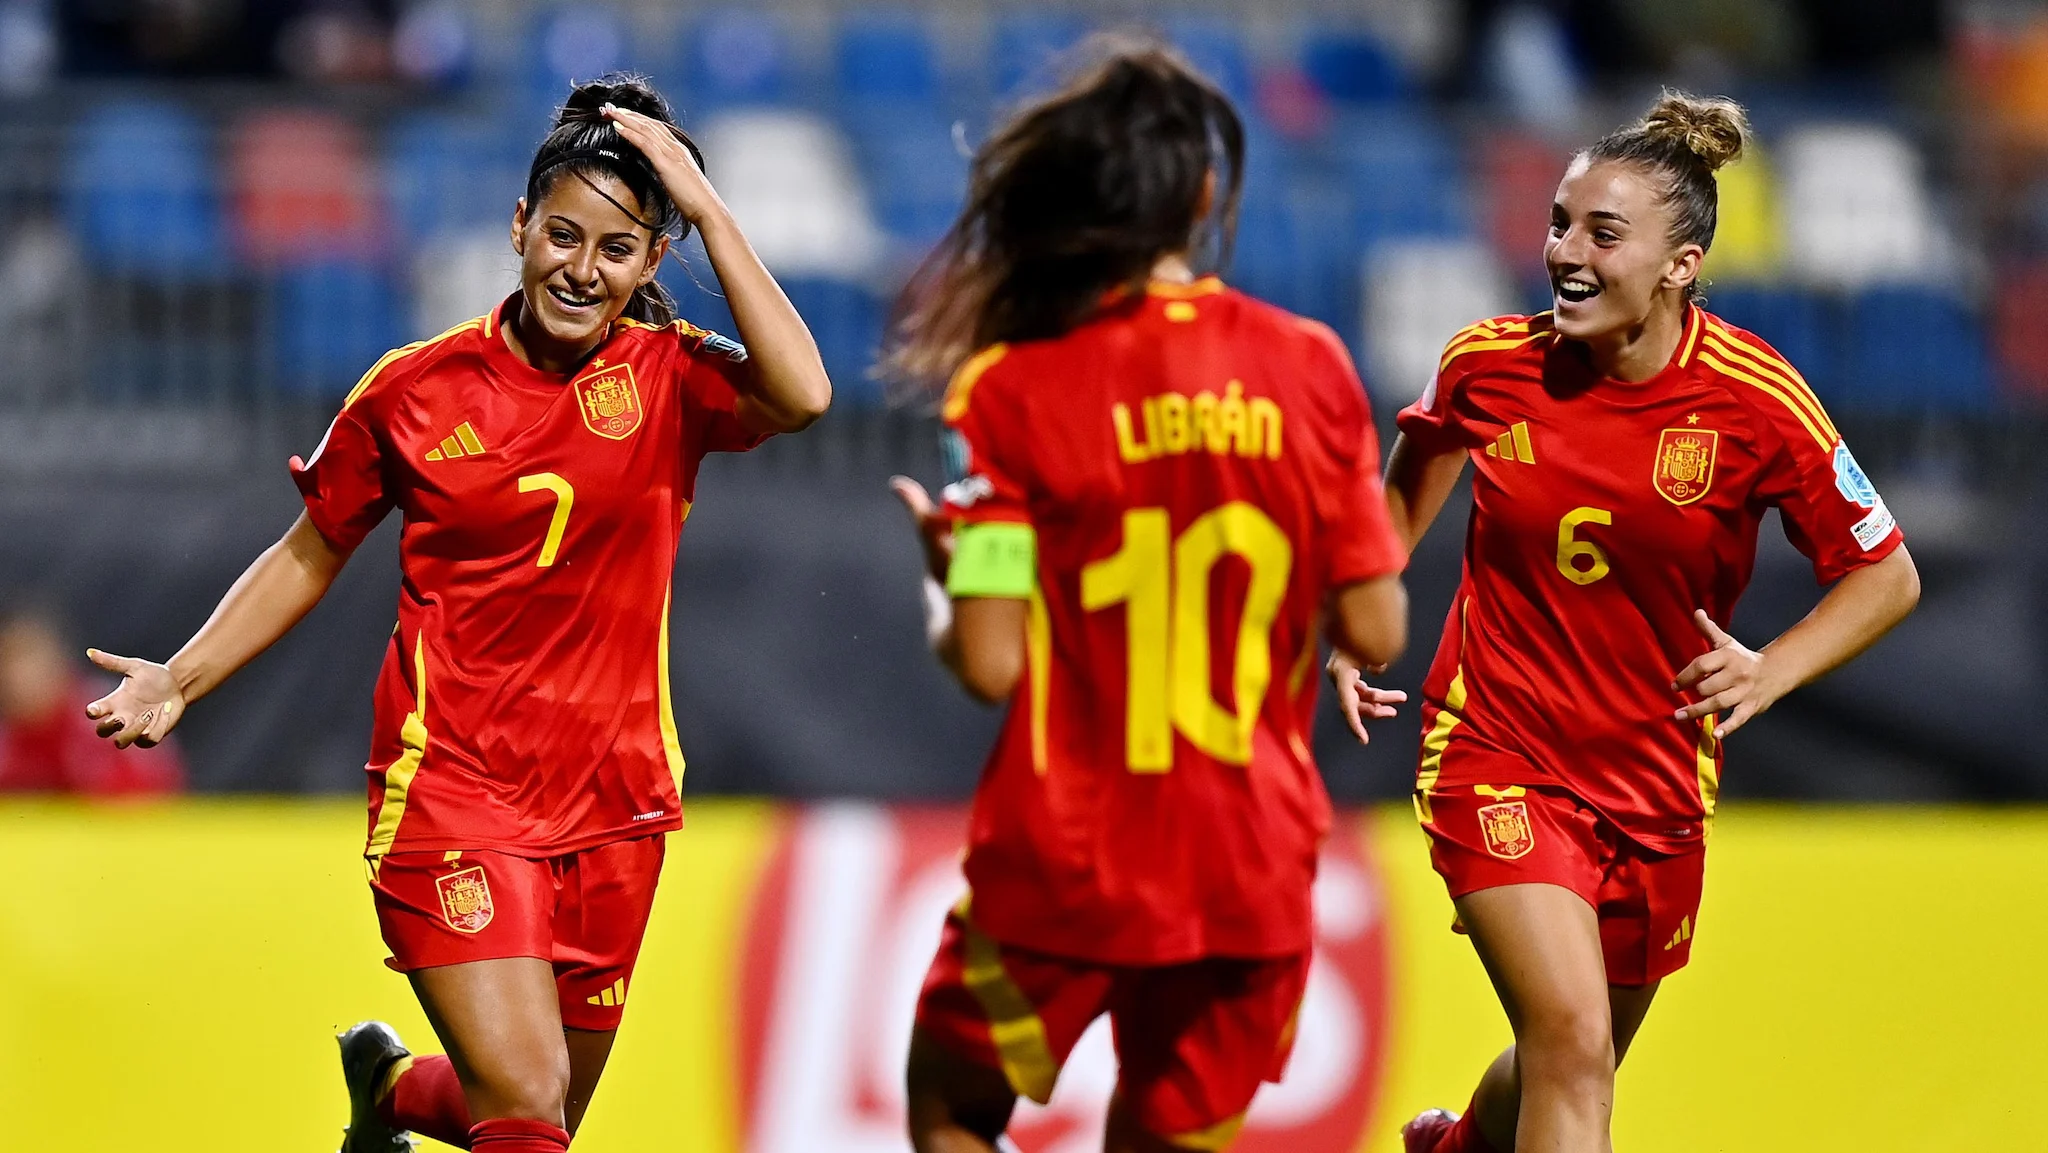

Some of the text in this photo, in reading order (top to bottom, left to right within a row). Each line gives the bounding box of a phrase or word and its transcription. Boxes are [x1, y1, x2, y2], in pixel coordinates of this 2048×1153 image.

[599, 149, 620, 160] NIKE
[518, 472, 574, 567] 7
[1556, 506, 1612, 585] 6
[1080, 500, 1293, 774] 10
